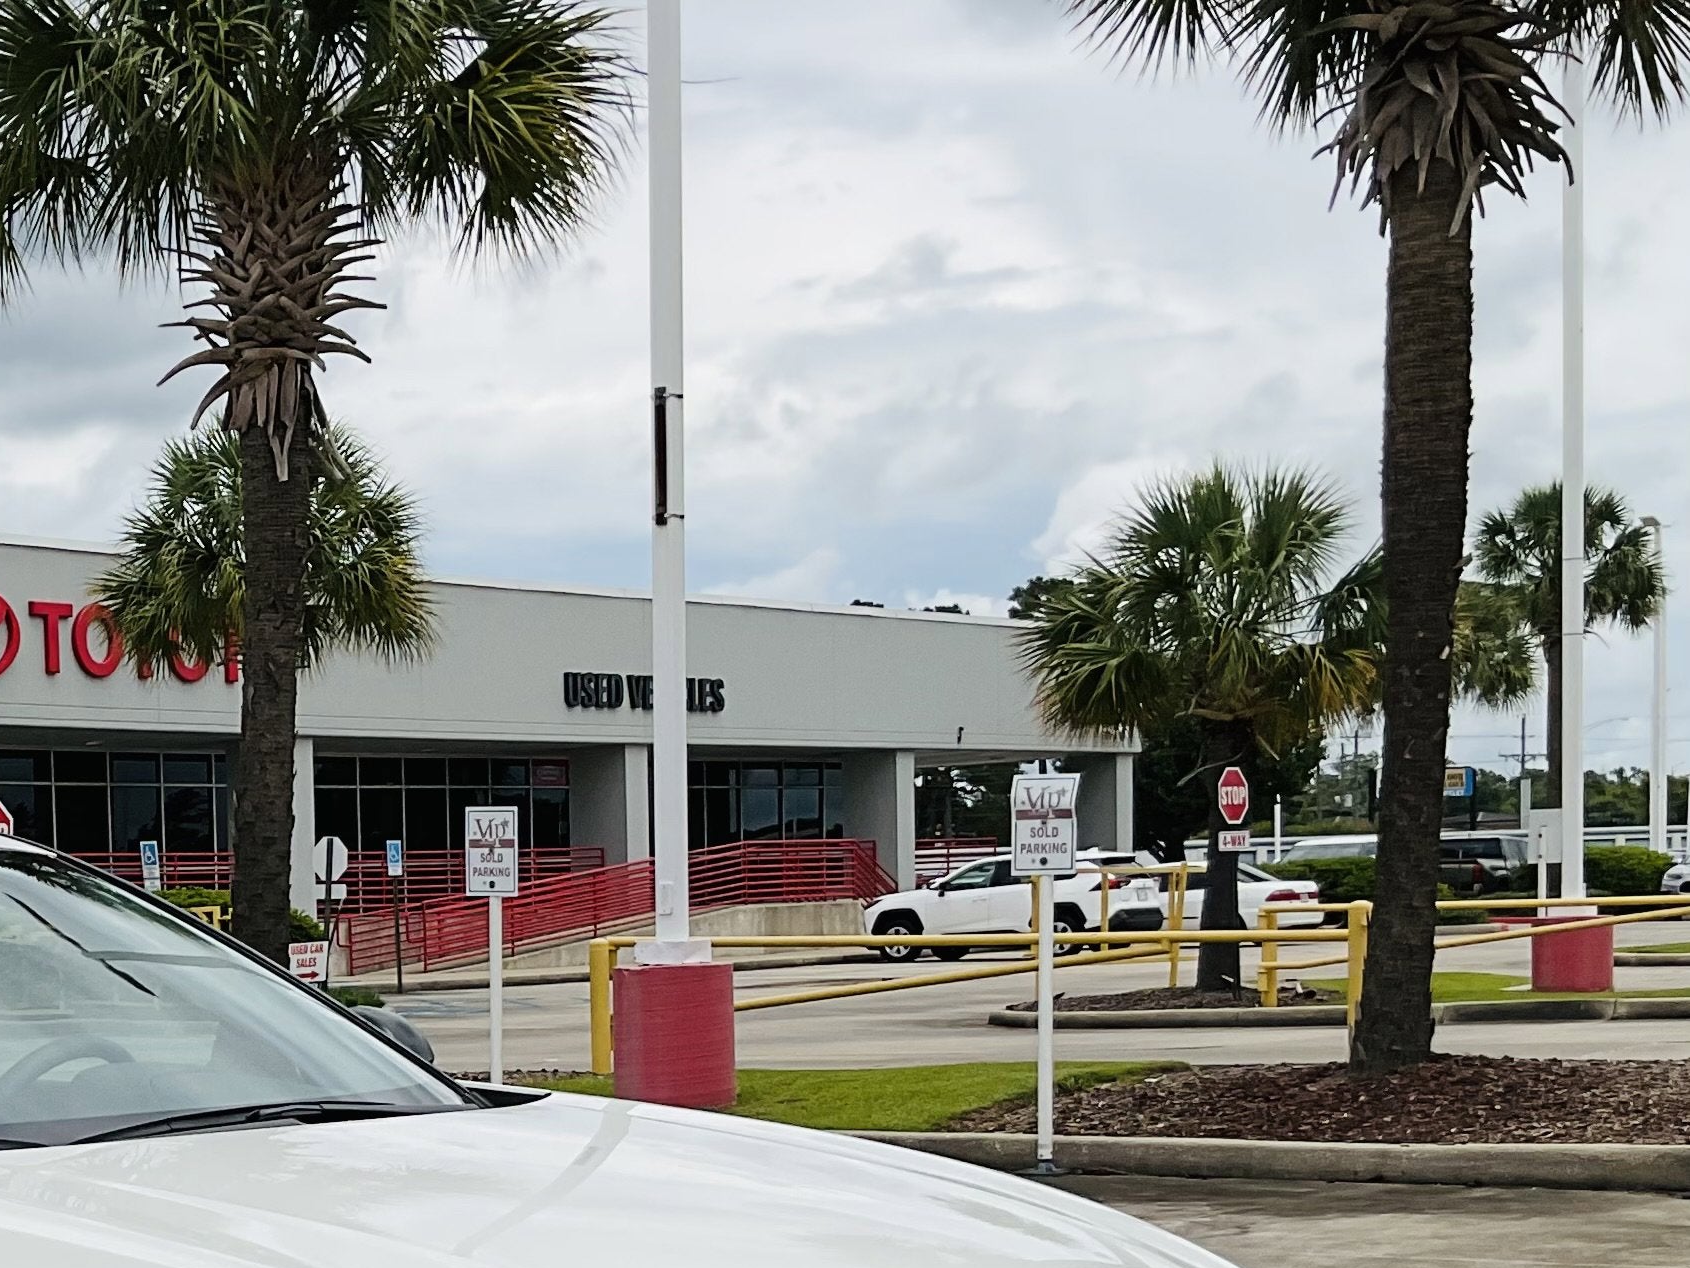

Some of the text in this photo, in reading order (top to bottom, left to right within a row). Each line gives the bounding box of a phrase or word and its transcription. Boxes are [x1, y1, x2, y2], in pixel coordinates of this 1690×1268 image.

[563, 672, 624, 708] USED
[1221, 786, 1246, 805] STOP
[1029, 826, 1059, 839] SOLD
[1222, 835, 1247, 848] 4-WAY
[1020, 842, 1068, 855] PARKING
[480, 852, 504, 864] SOLD
[472, 866, 511, 878] PARKING
[290, 943, 324, 955] USED CAR
[296, 957, 317, 968] SALES
